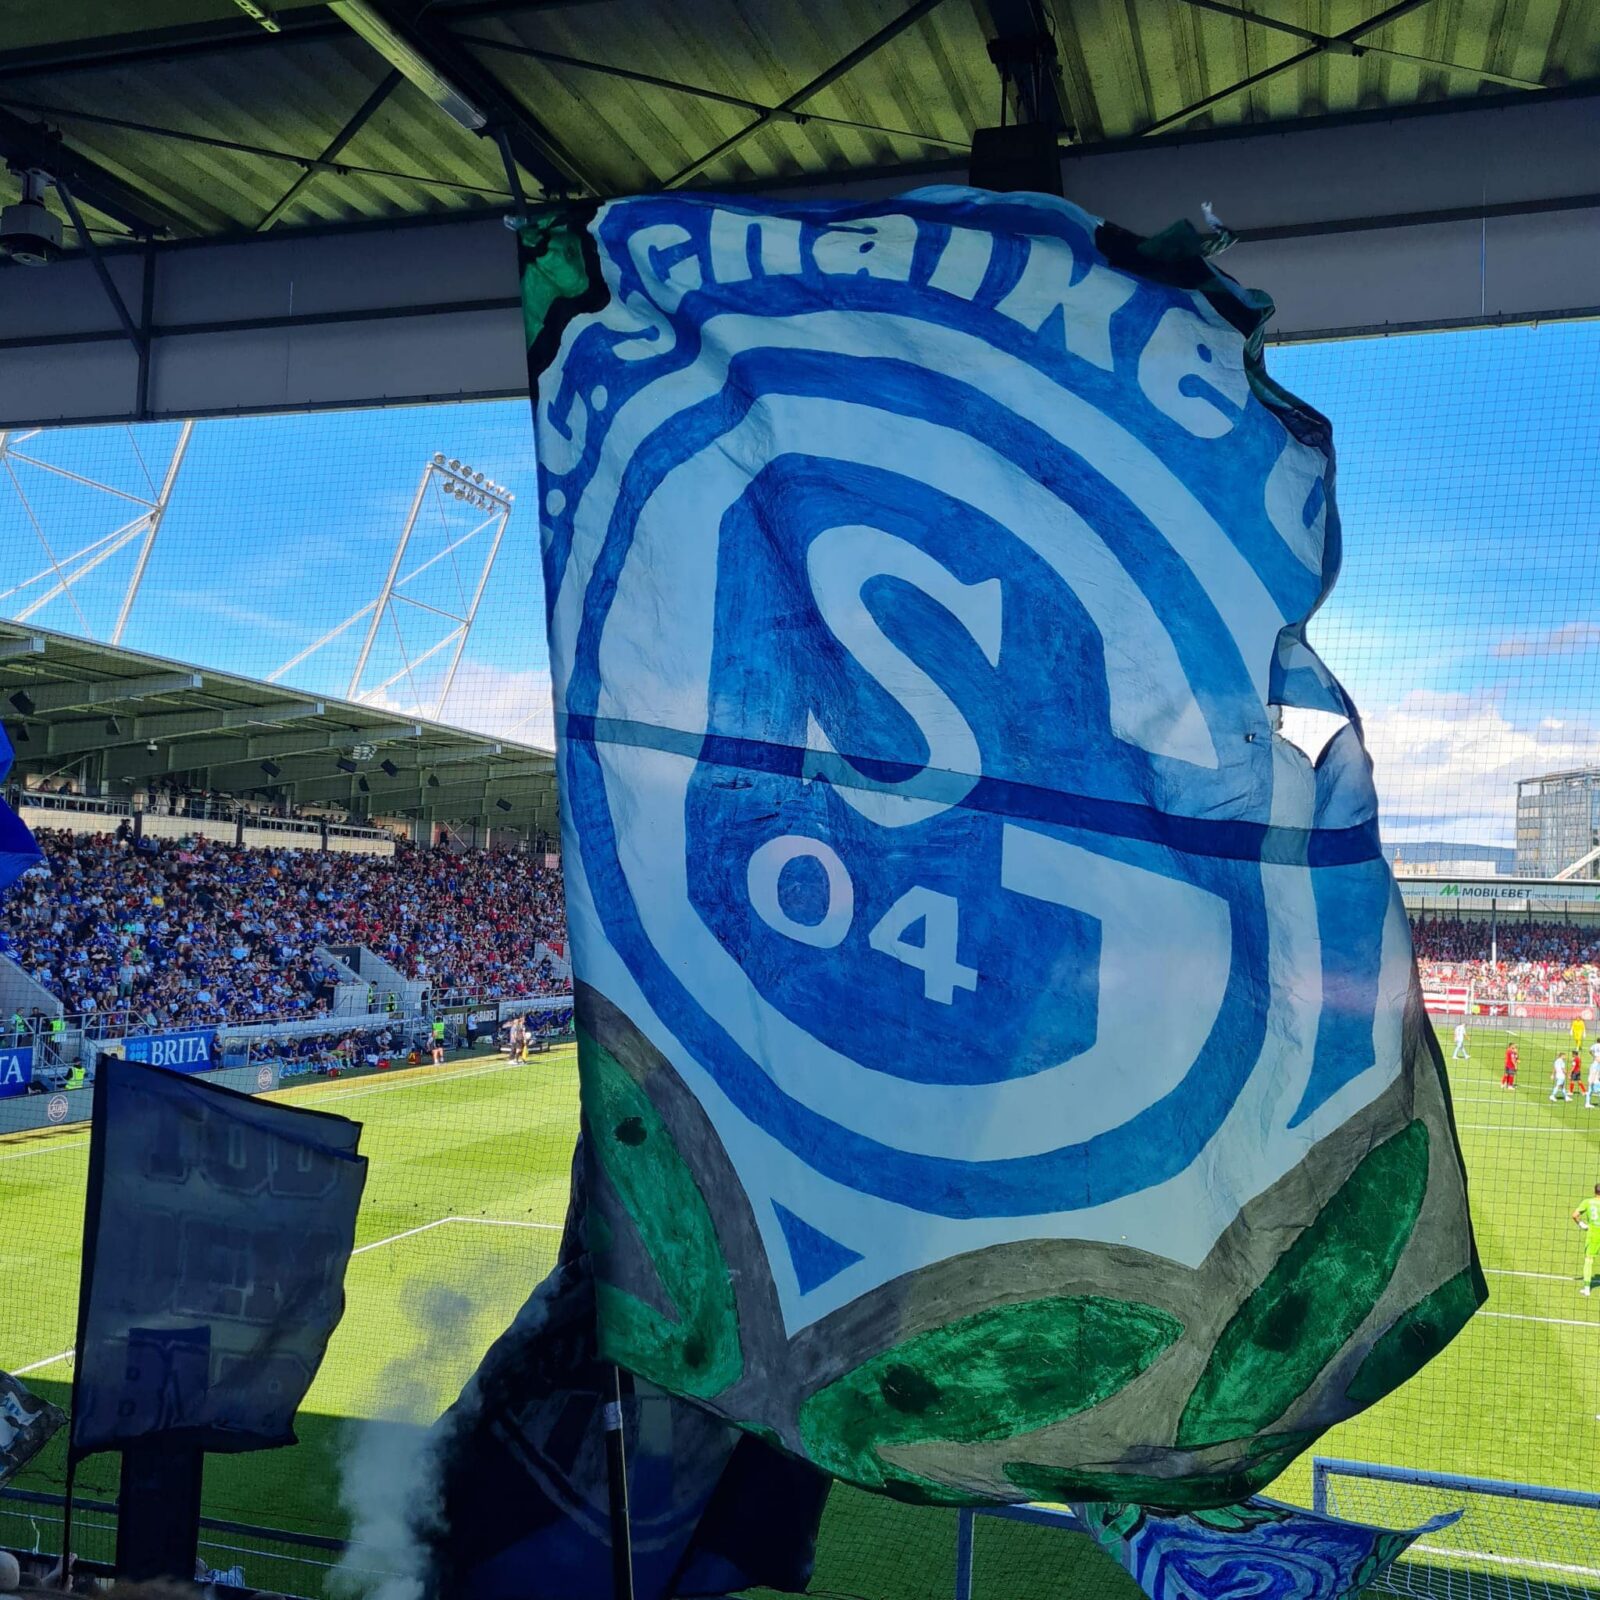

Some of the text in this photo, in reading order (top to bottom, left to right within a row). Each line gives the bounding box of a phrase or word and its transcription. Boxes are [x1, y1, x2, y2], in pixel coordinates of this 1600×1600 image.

[806, 524, 1002, 829] S
[746, 834, 985, 1007] 04
[1462, 887, 1533, 899] MOBILEBET
[151, 1036, 209, 1066] BRITA
